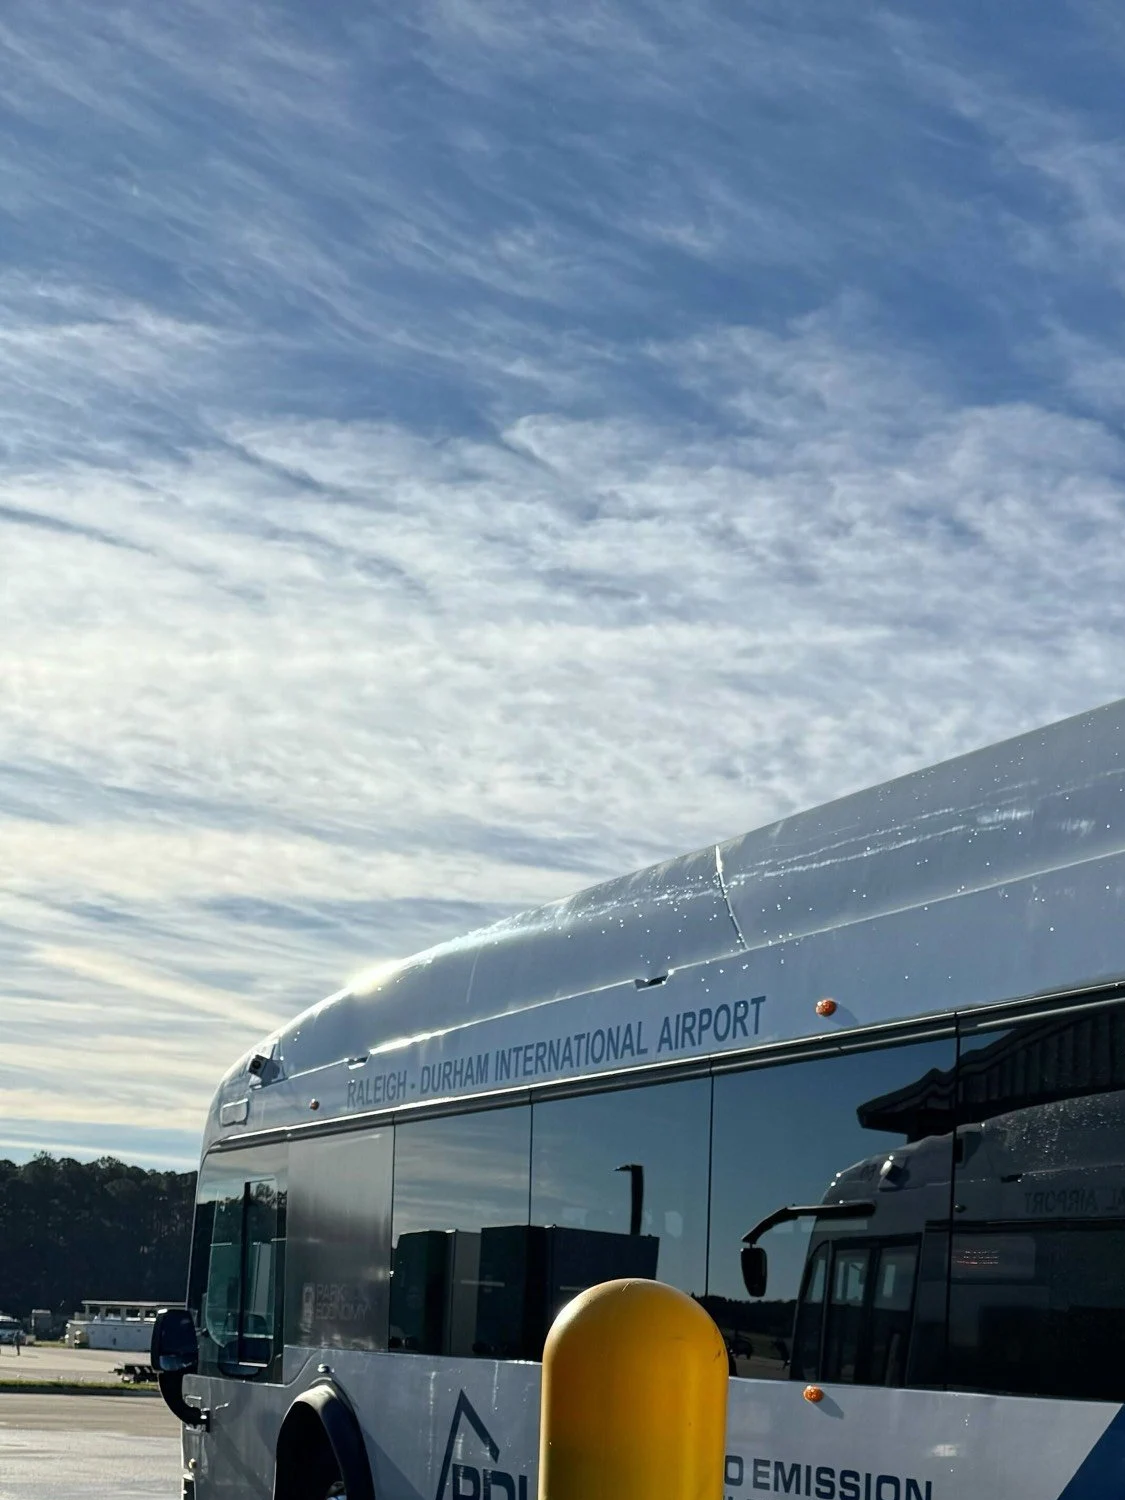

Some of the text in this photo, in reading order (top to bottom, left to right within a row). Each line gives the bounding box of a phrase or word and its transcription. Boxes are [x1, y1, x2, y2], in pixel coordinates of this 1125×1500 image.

[347, 1072, 407, 1108] RALEIGH
[420, 1052, 490, 1095] DURHAM
[494, 1021, 648, 1083] INTERNATIONAL
[657, 995, 766, 1053] AIRPORT
